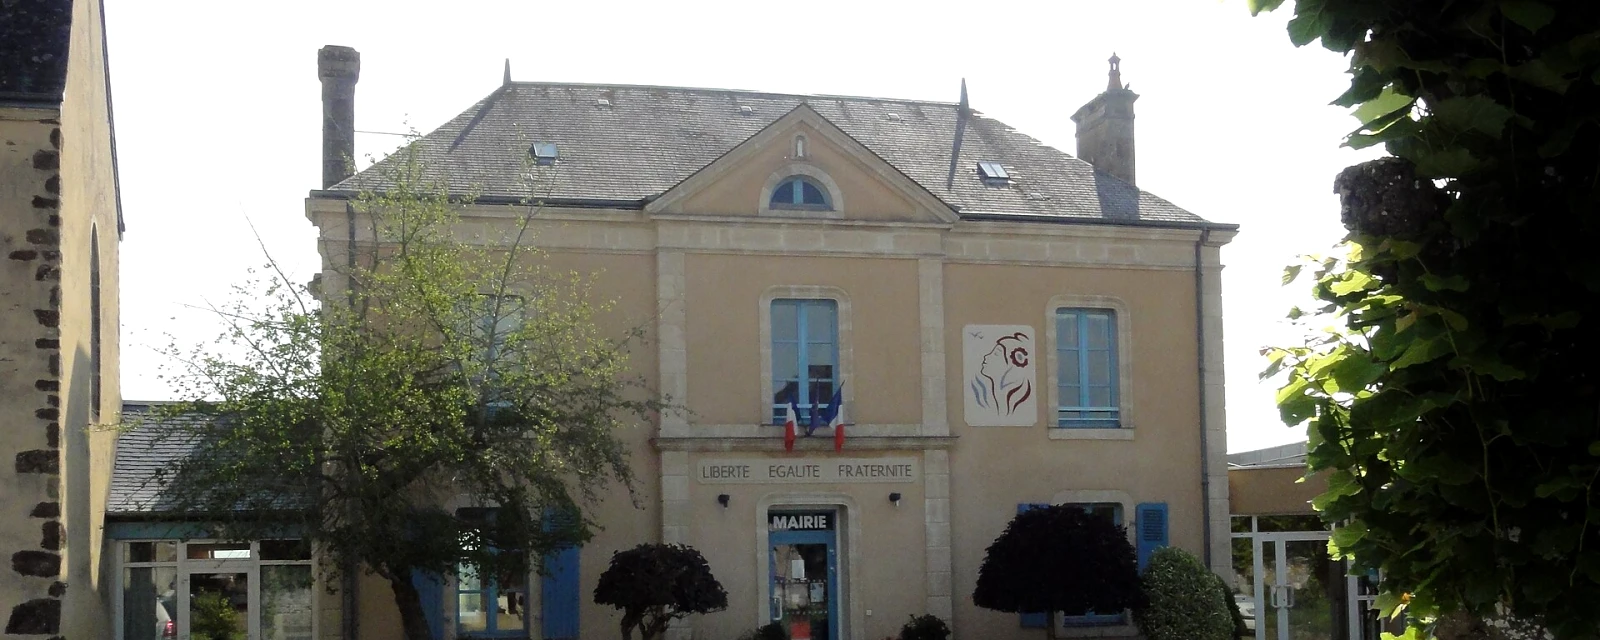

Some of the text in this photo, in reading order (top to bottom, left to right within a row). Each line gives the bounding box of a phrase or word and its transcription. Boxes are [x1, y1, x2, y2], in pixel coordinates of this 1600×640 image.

[702, 464, 912, 479] LIBERTE EGALITE FRATERNITE
[772, 515, 827, 529] MAIRIE
